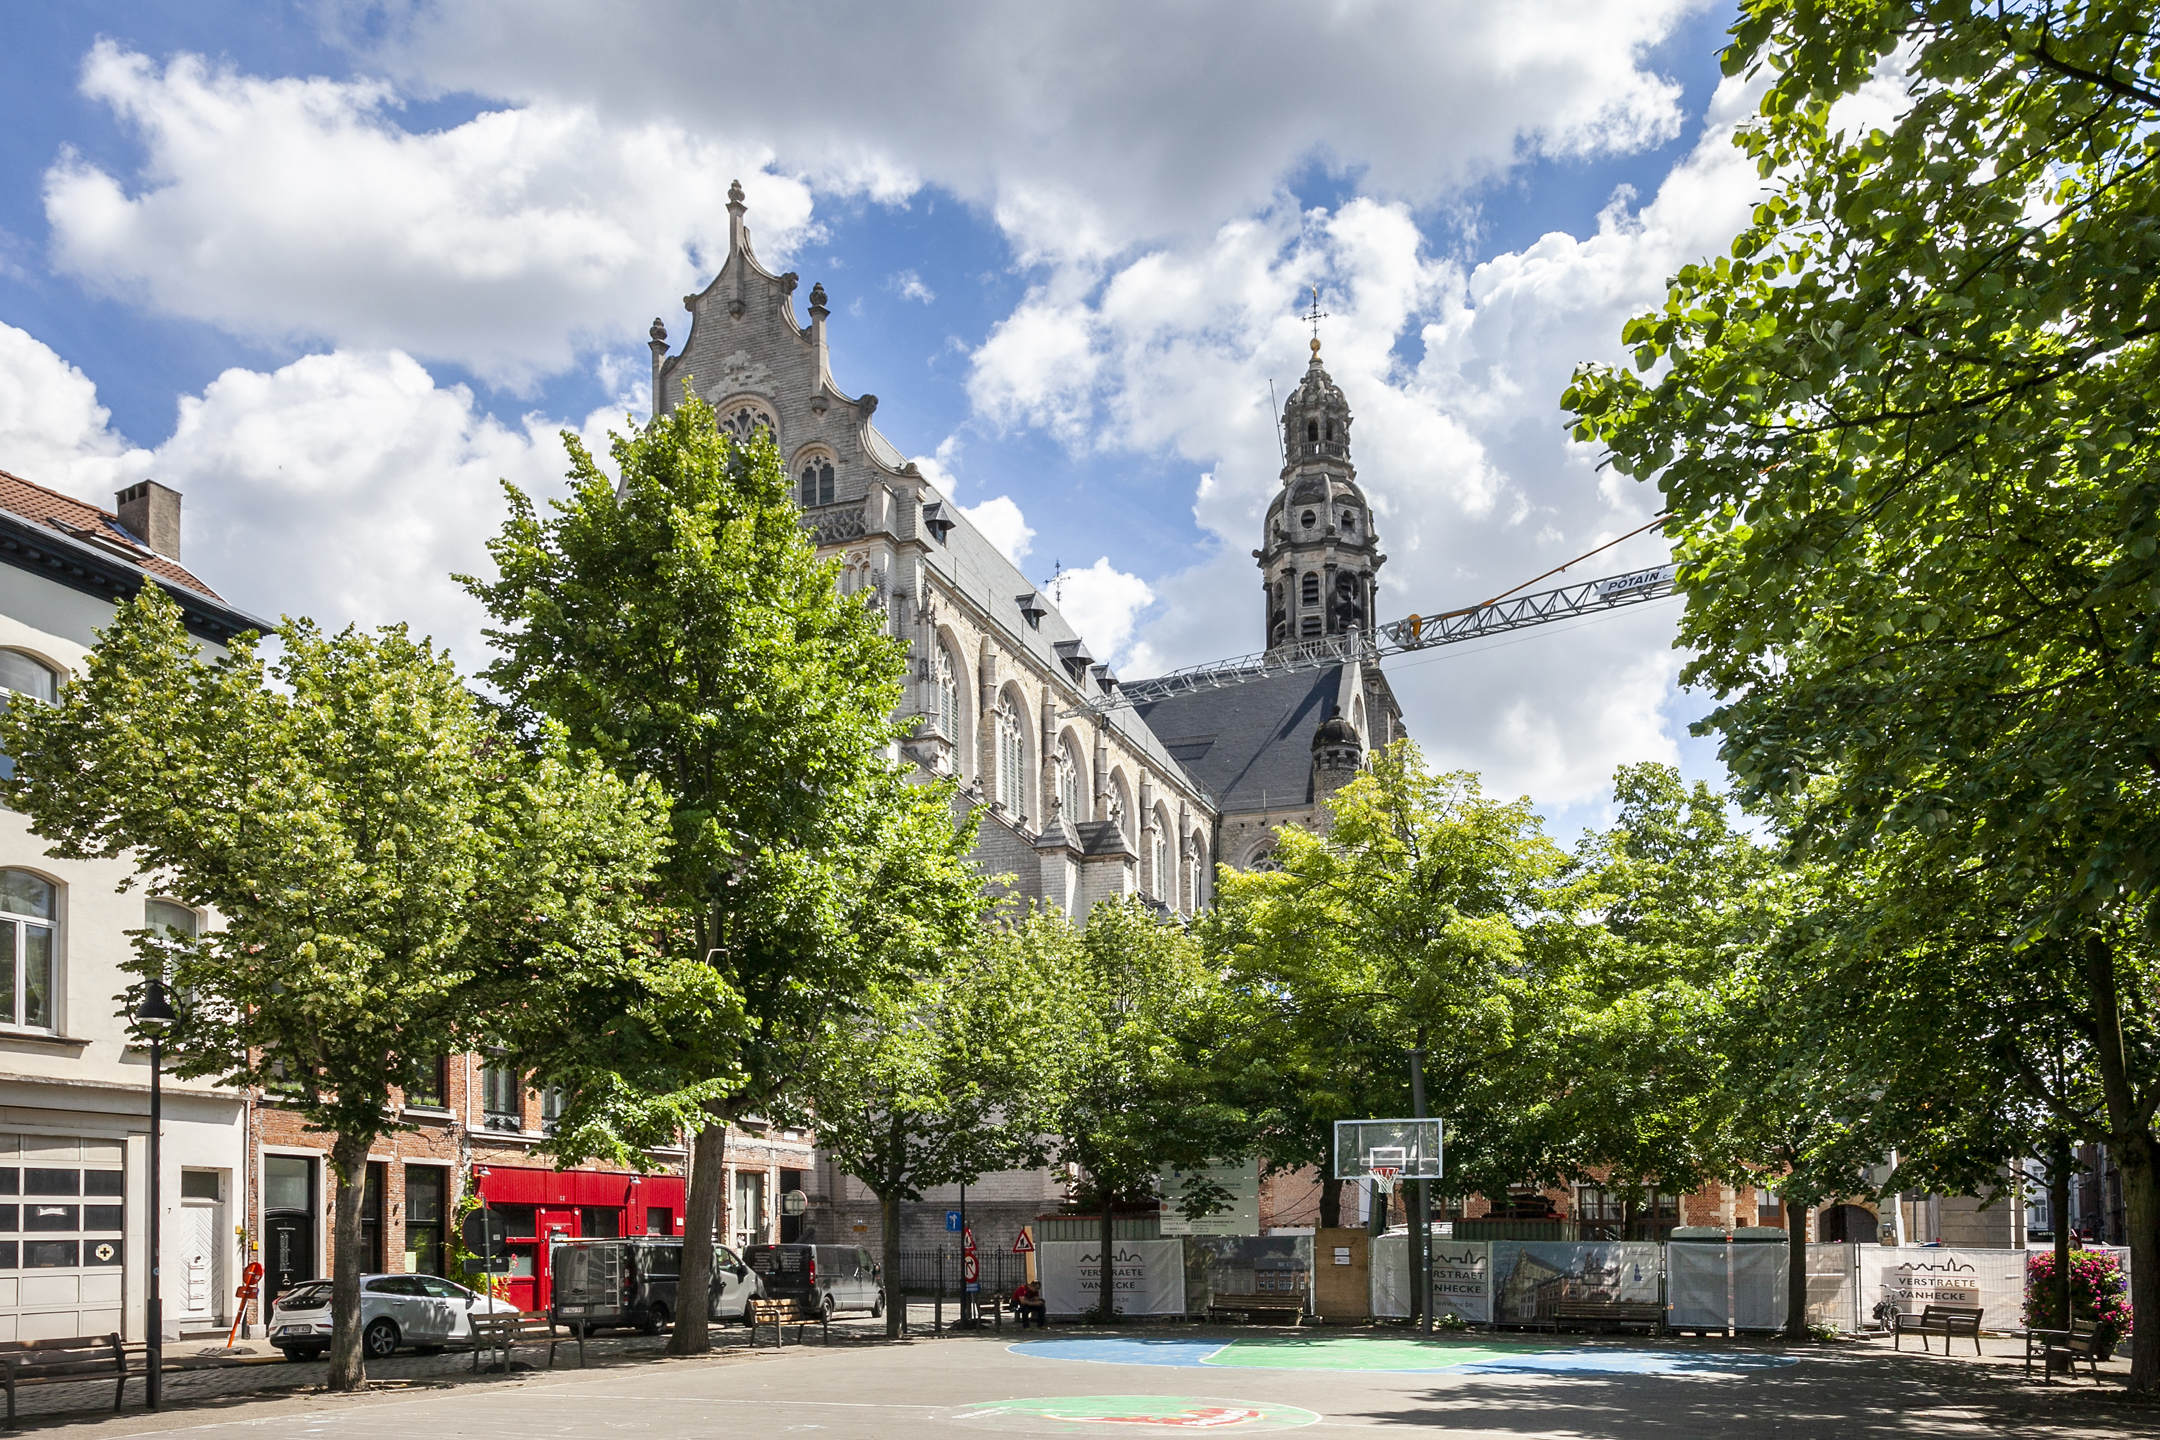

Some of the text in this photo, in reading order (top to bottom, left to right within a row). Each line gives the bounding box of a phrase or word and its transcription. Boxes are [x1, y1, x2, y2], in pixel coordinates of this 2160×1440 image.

[1608, 572, 1659, 591] POTAIN
[167, 1207, 172, 1215] 7
[1080, 1269, 1143, 1277] VERSRAETE
[1433, 1270, 1484, 1279] RSTRAET
[1899, 1278, 1975, 1287] VERSTRAETE
[1434, 1284, 1481, 1293] NHECKE
[1899, 1291, 1965, 1300] VANHECKE
